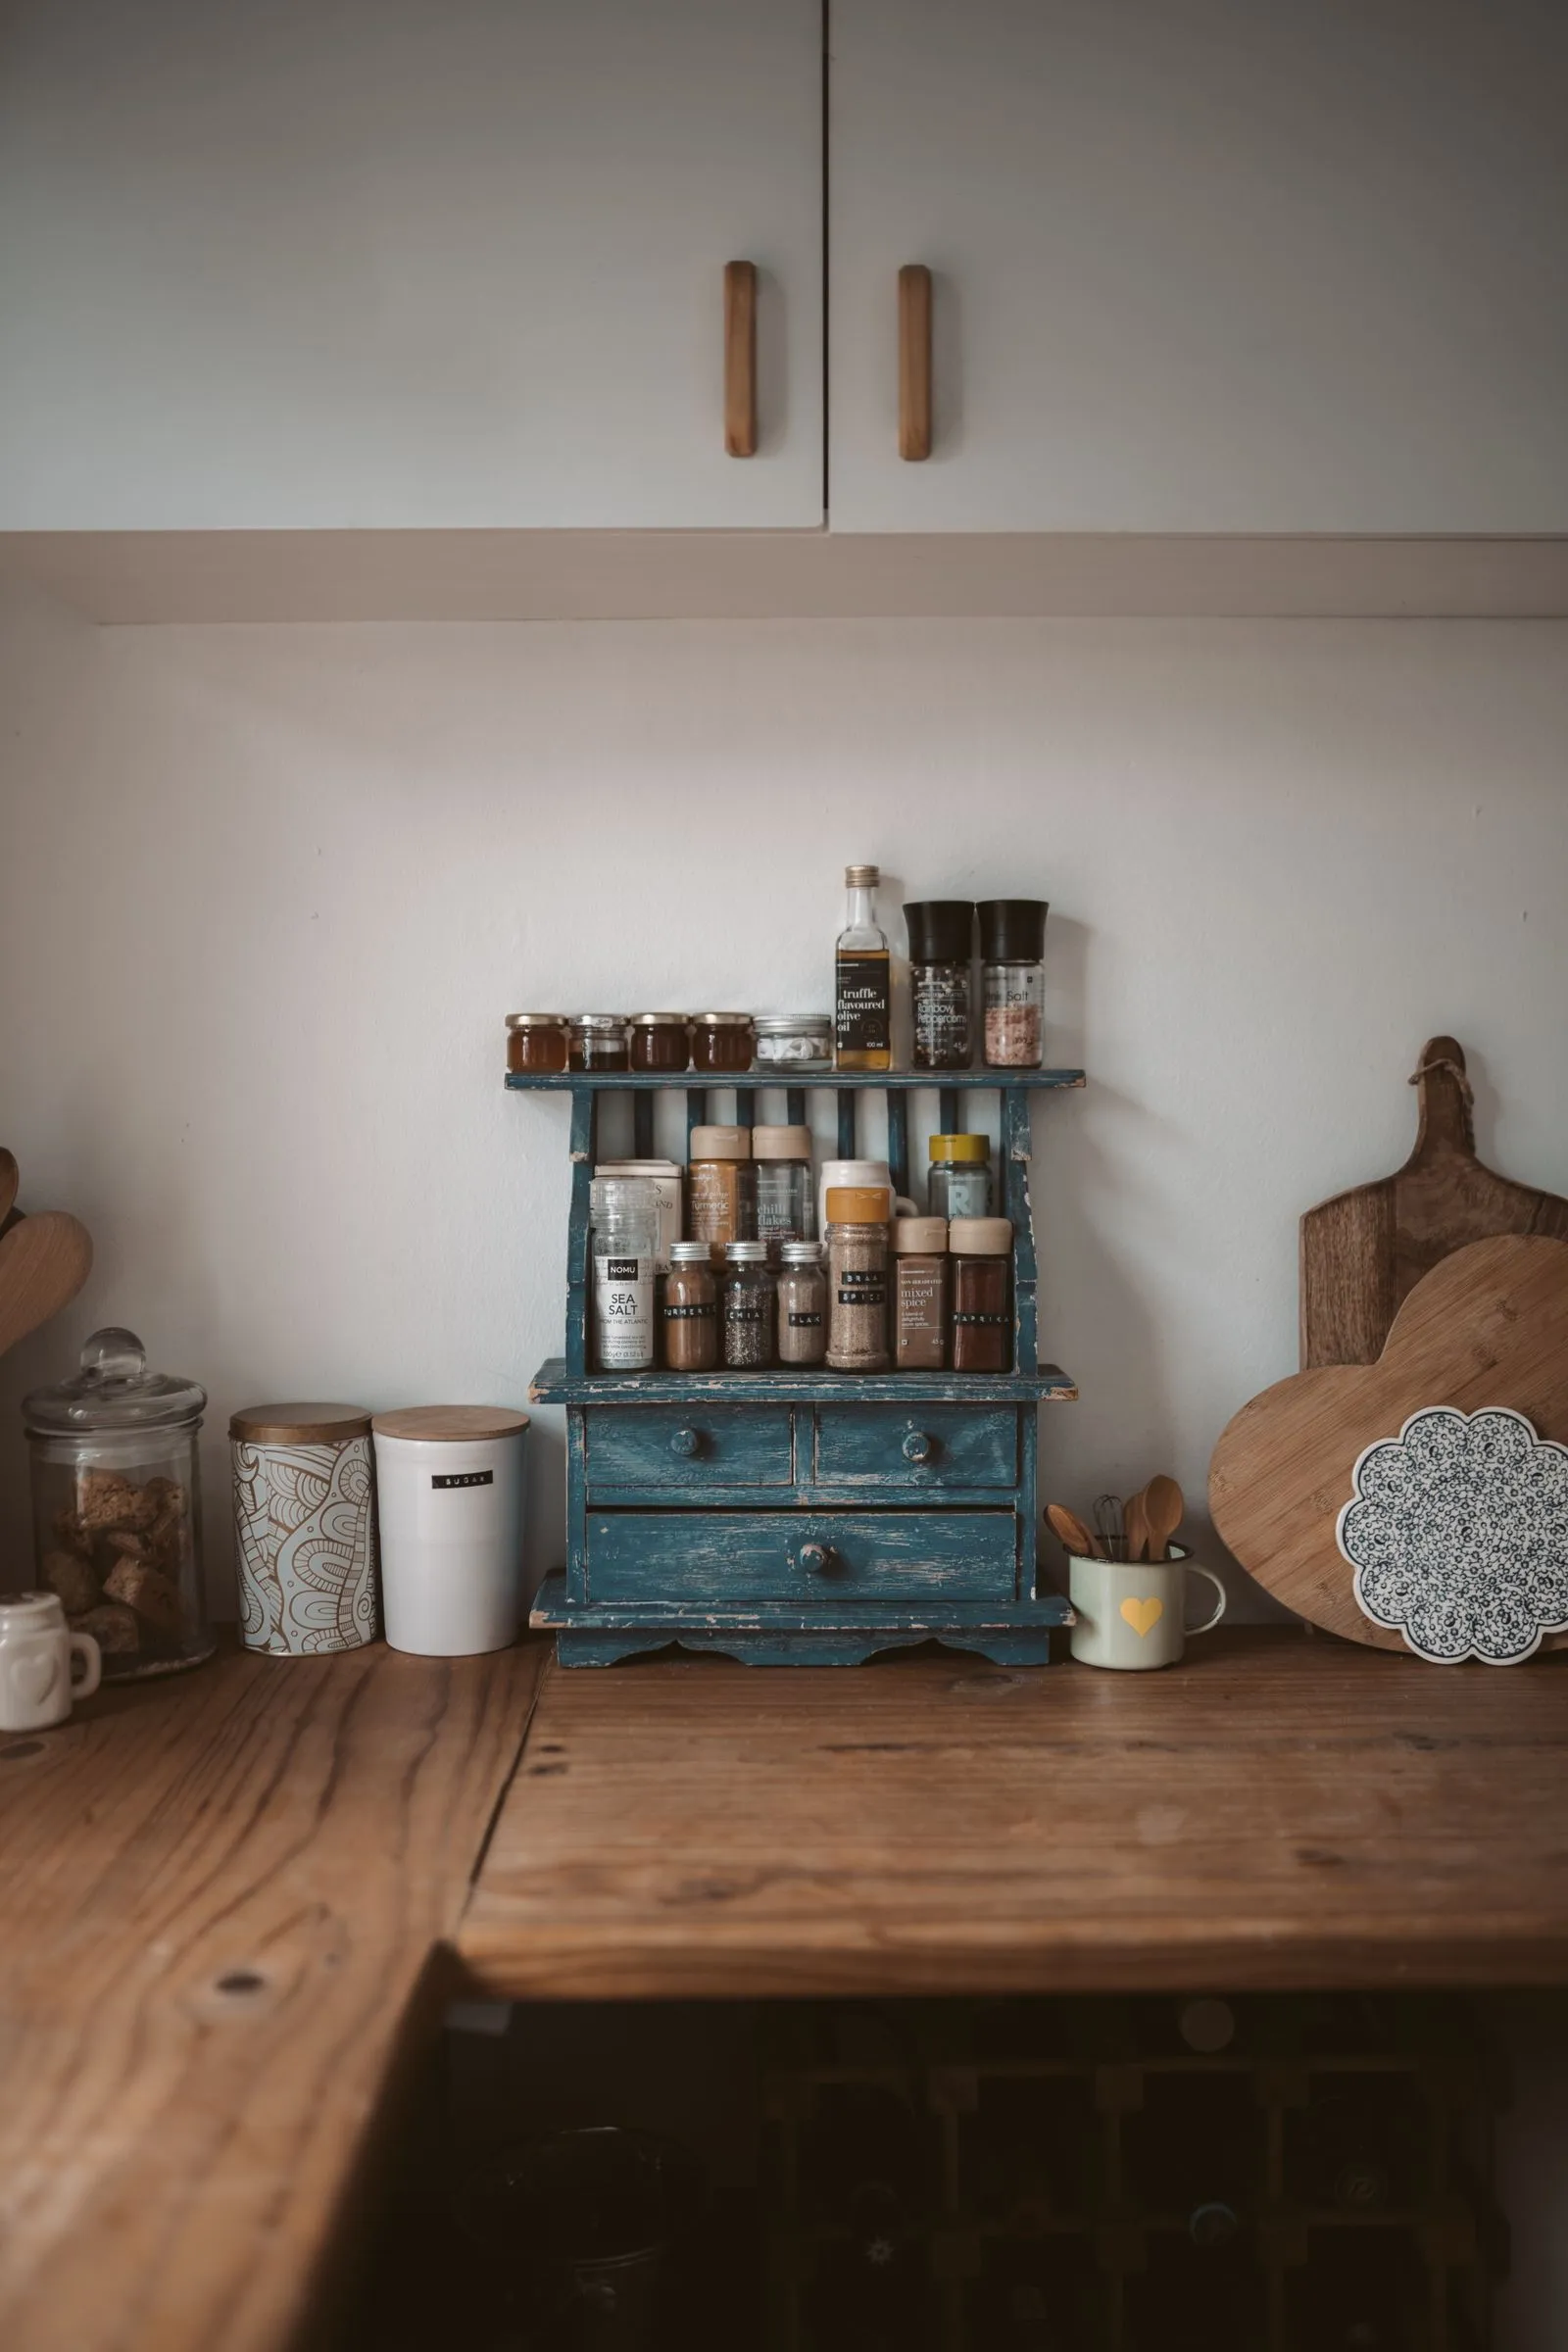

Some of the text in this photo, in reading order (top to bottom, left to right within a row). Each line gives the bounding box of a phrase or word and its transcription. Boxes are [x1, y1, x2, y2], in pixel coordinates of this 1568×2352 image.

[843, 988, 877, 999] truffle
[1006, 990, 1029, 1001] Salt
[838, 999, 885, 1010] flavoured
[838, 1010, 860, 1021] olive
[838, 1021, 850, 1032] oil
[948, 1185, 971, 1215] R
[758, 1214, 792, 1226] flakes
[901, 1287, 934, 1298] mixed
[611, 1294, 635, 1304] SEA
[901, 1298, 927, 1309] spice
[609, 1304, 638, 1315] SALT
[953, 1314, 1010, 1323] PAPRIKA
[446, 1476, 485, 1486] SUGAR
